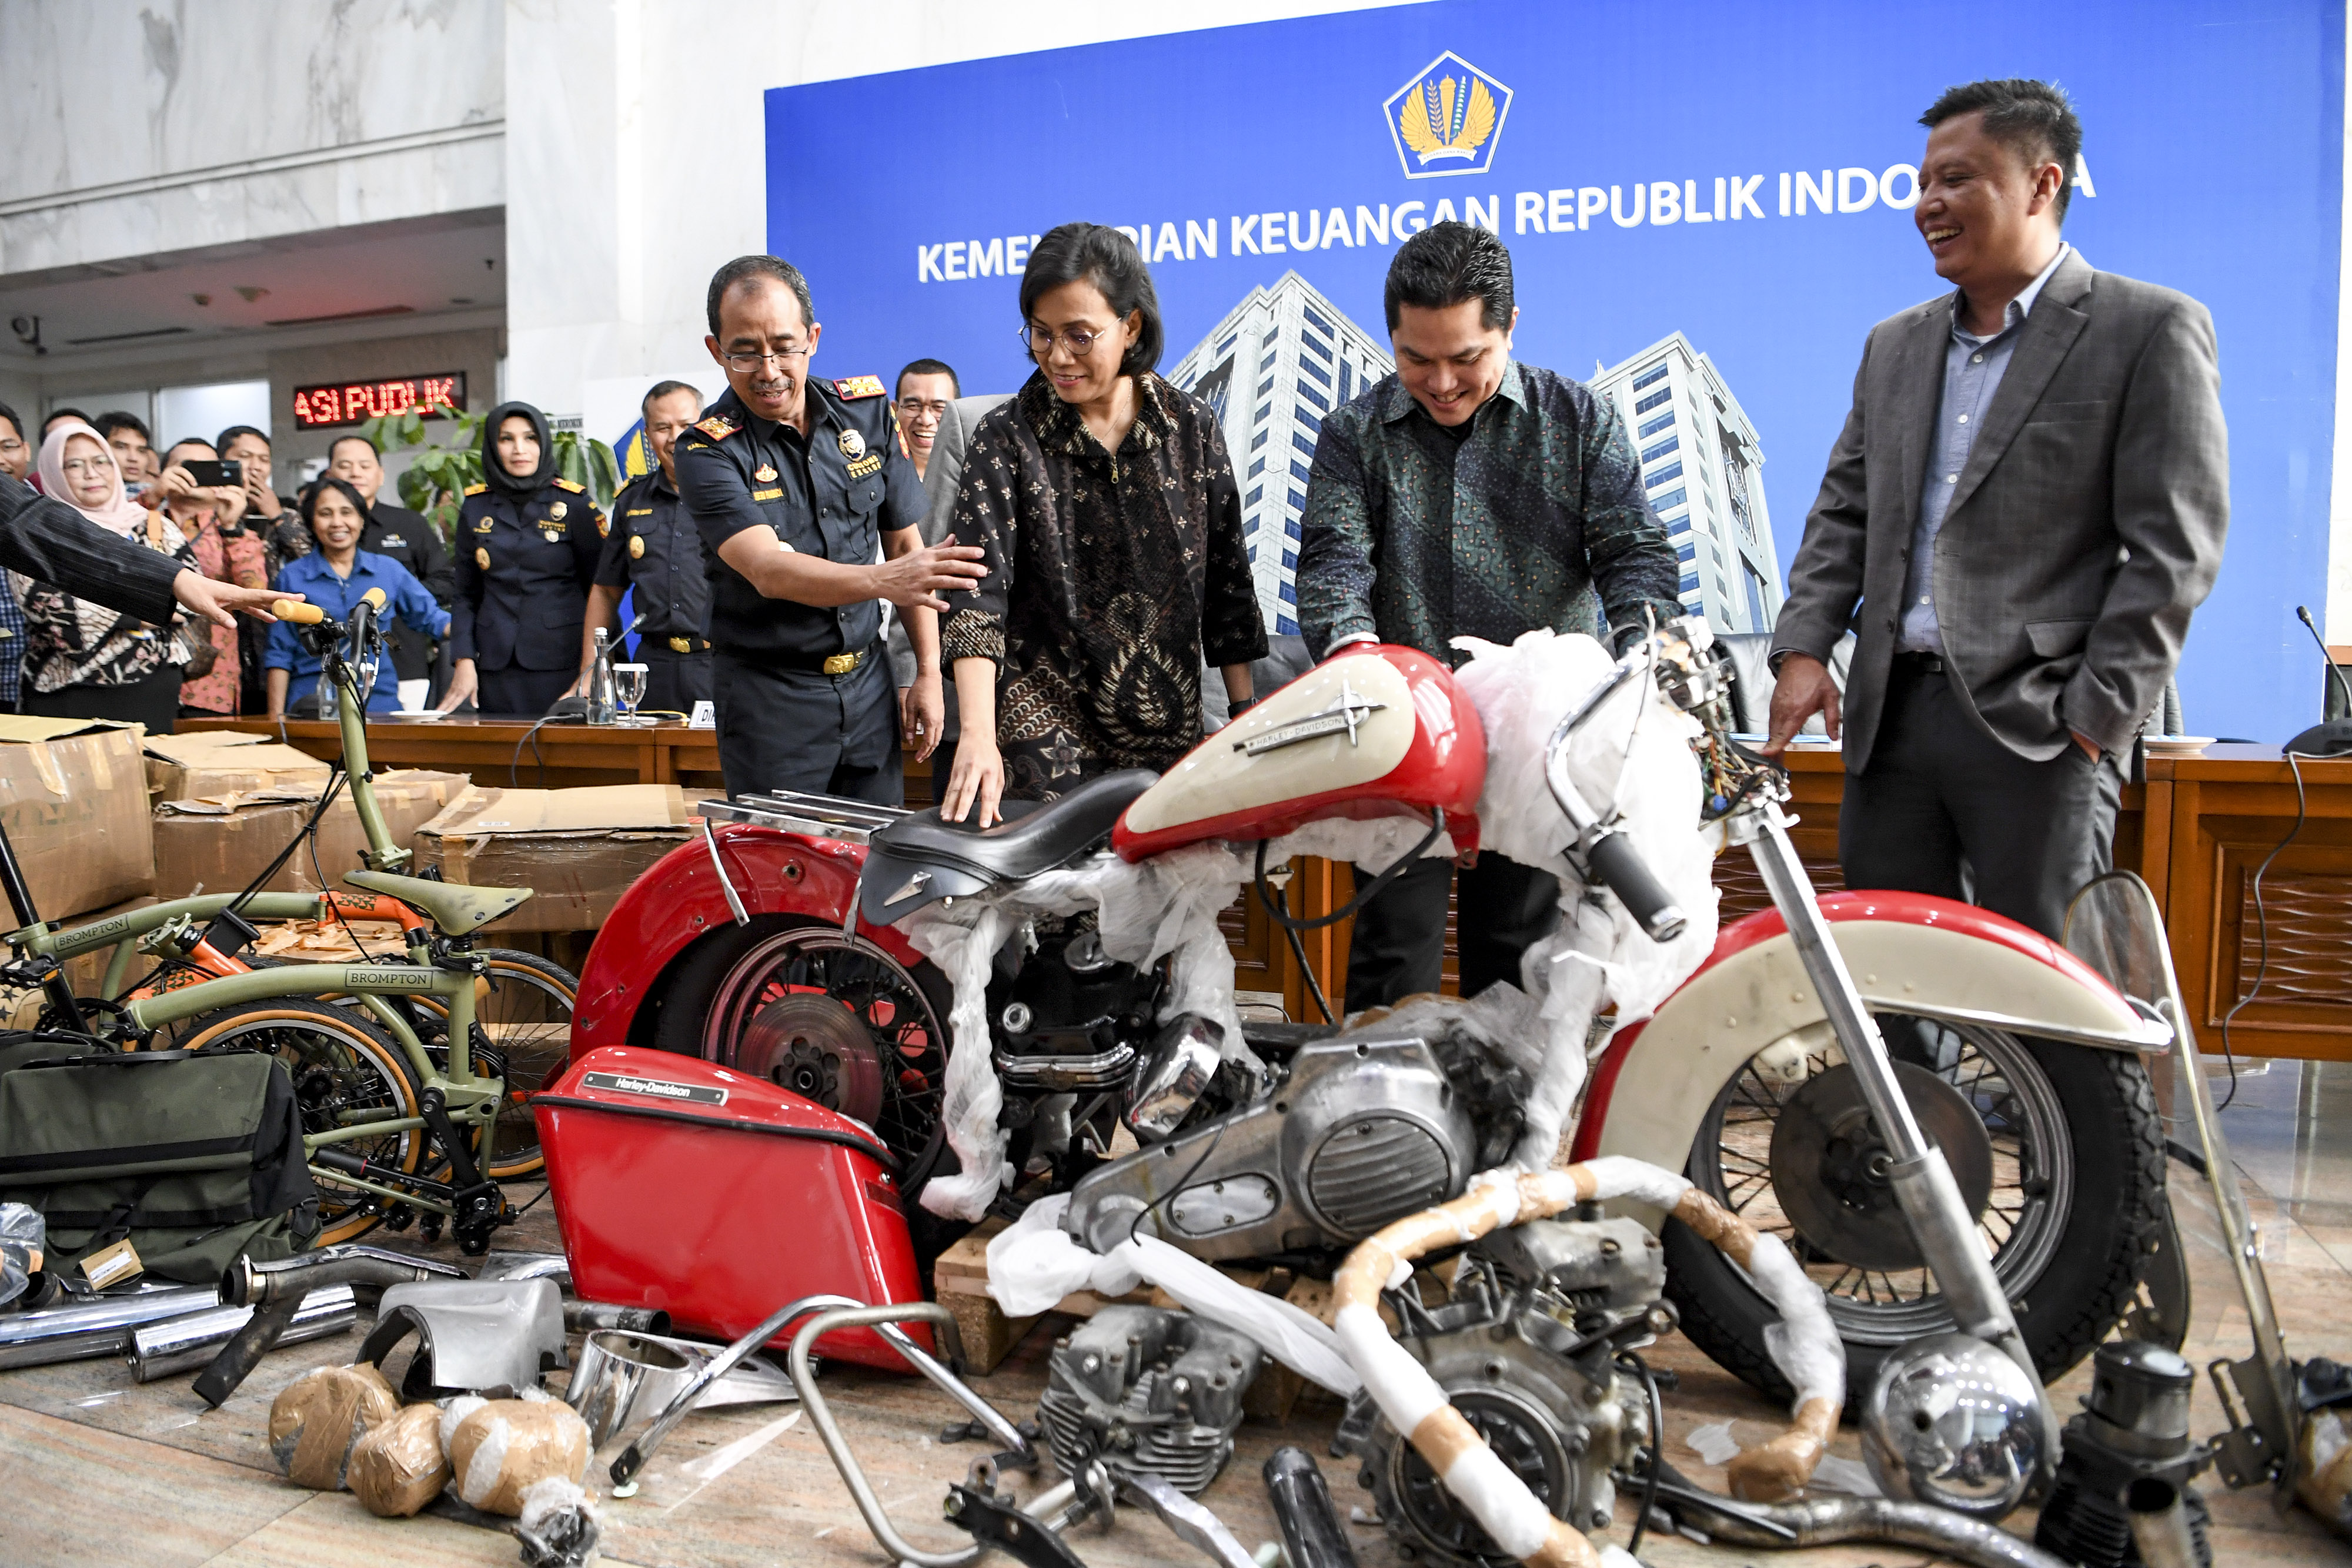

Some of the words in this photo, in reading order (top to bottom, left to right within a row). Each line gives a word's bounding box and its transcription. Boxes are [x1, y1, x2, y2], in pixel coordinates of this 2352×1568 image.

[918, 218, 1218, 283] KEMEIAN
[1231, 195, 1501, 257] KEUANGAN
[1515, 174, 1766, 235] REPUBLIK
[1779, 152, 2097, 218] INDOA
[850, 462, 882, 479] EXCISE
[59, 919, 123, 946] BROMPTON
[350, 973, 427, 984] BROMPTON
[615, 1077, 691, 1098] Harley-Davidson
